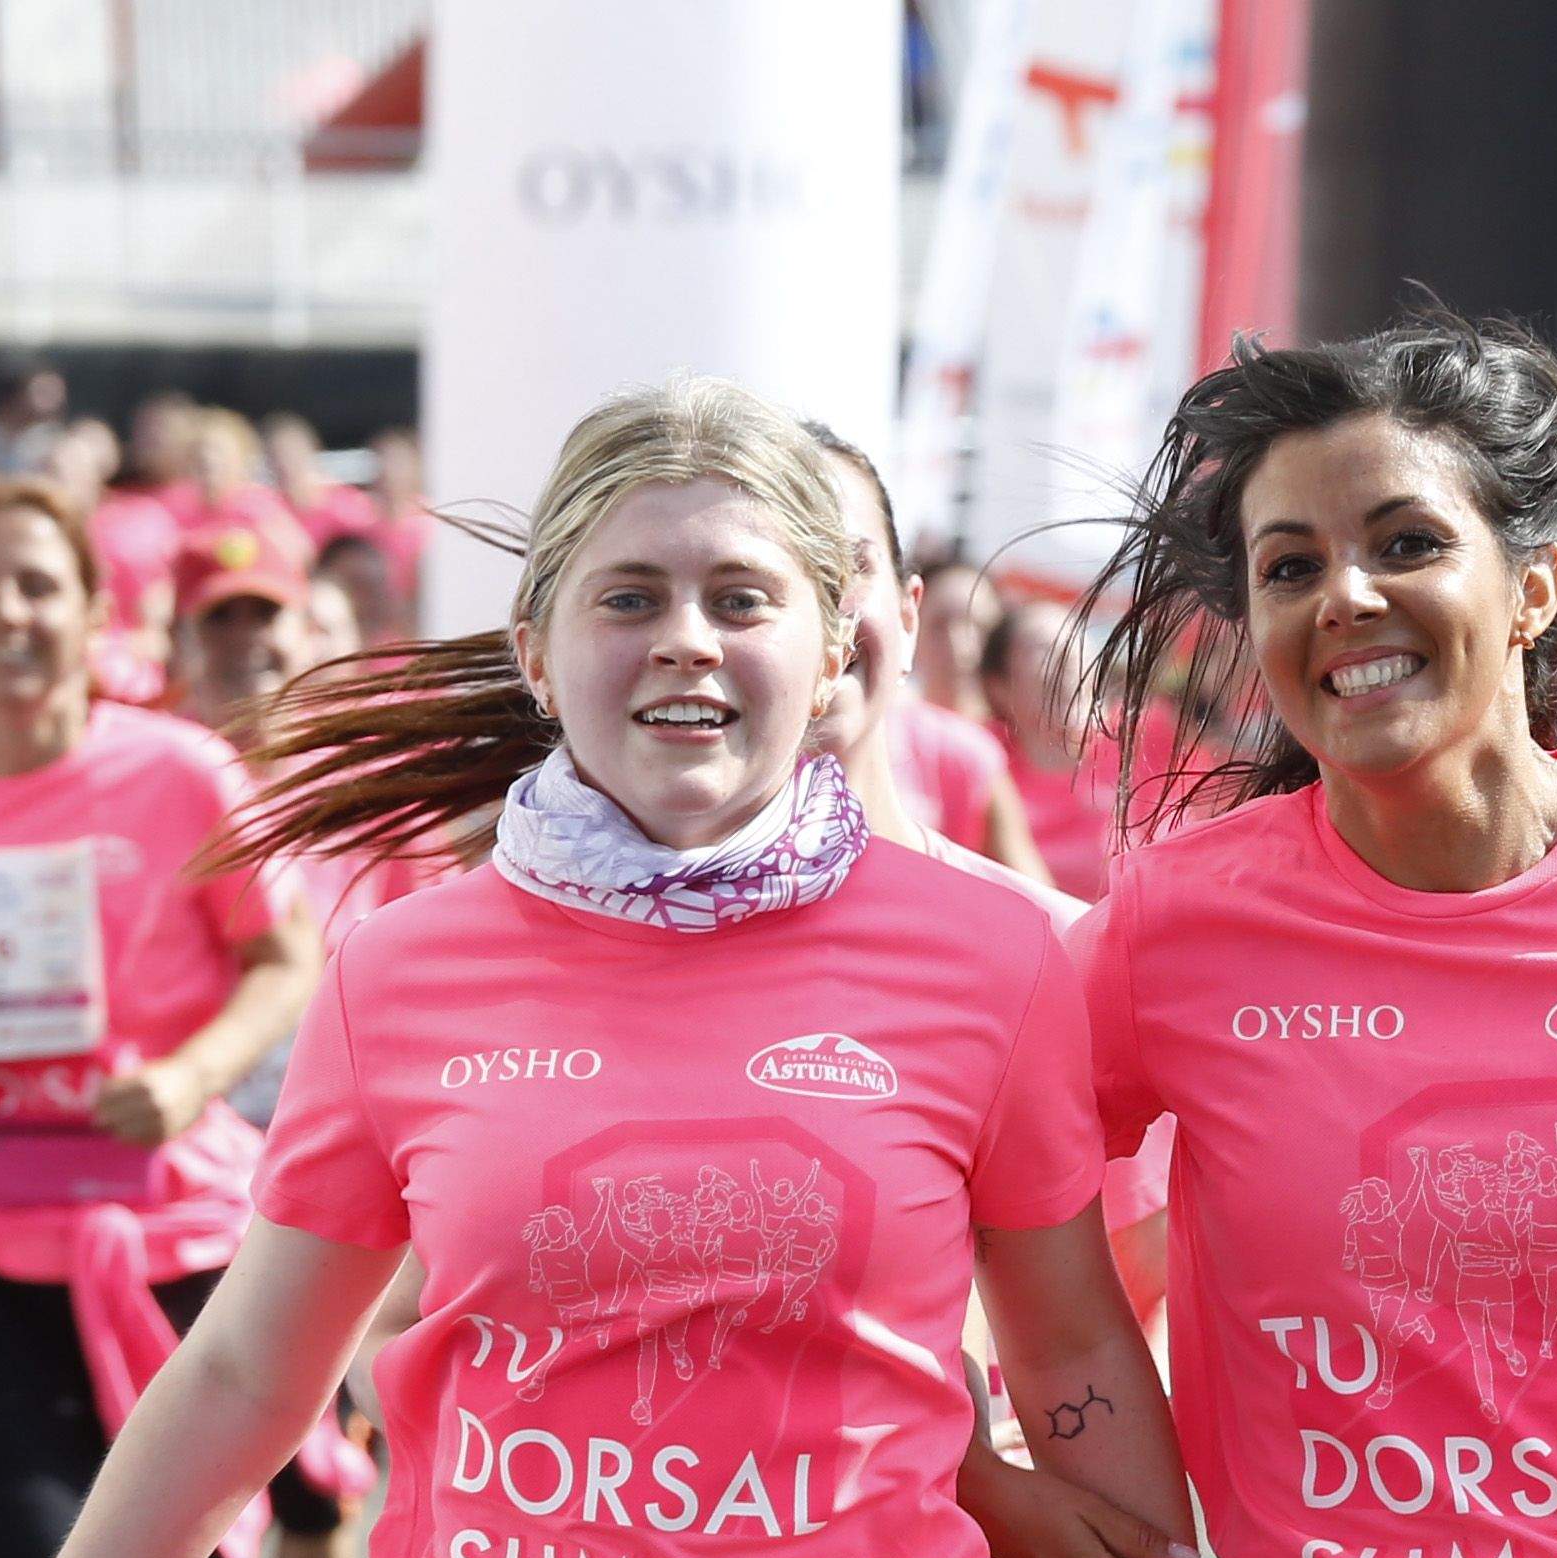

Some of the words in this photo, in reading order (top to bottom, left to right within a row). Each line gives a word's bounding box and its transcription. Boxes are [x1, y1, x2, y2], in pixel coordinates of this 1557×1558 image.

[1232, 1004, 1405, 1041] OYSHO
[441, 1048, 602, 1089] OYSHO
[758, 1056, 889, 1093] ASTURIANA
[783, 1053, 834, 1064] CENTRAL
[452, 1314, 563, 1382] TU
[1260, 1317, 1378, 1395] TU
[451, 1406, 828, 1538] DORSAL
